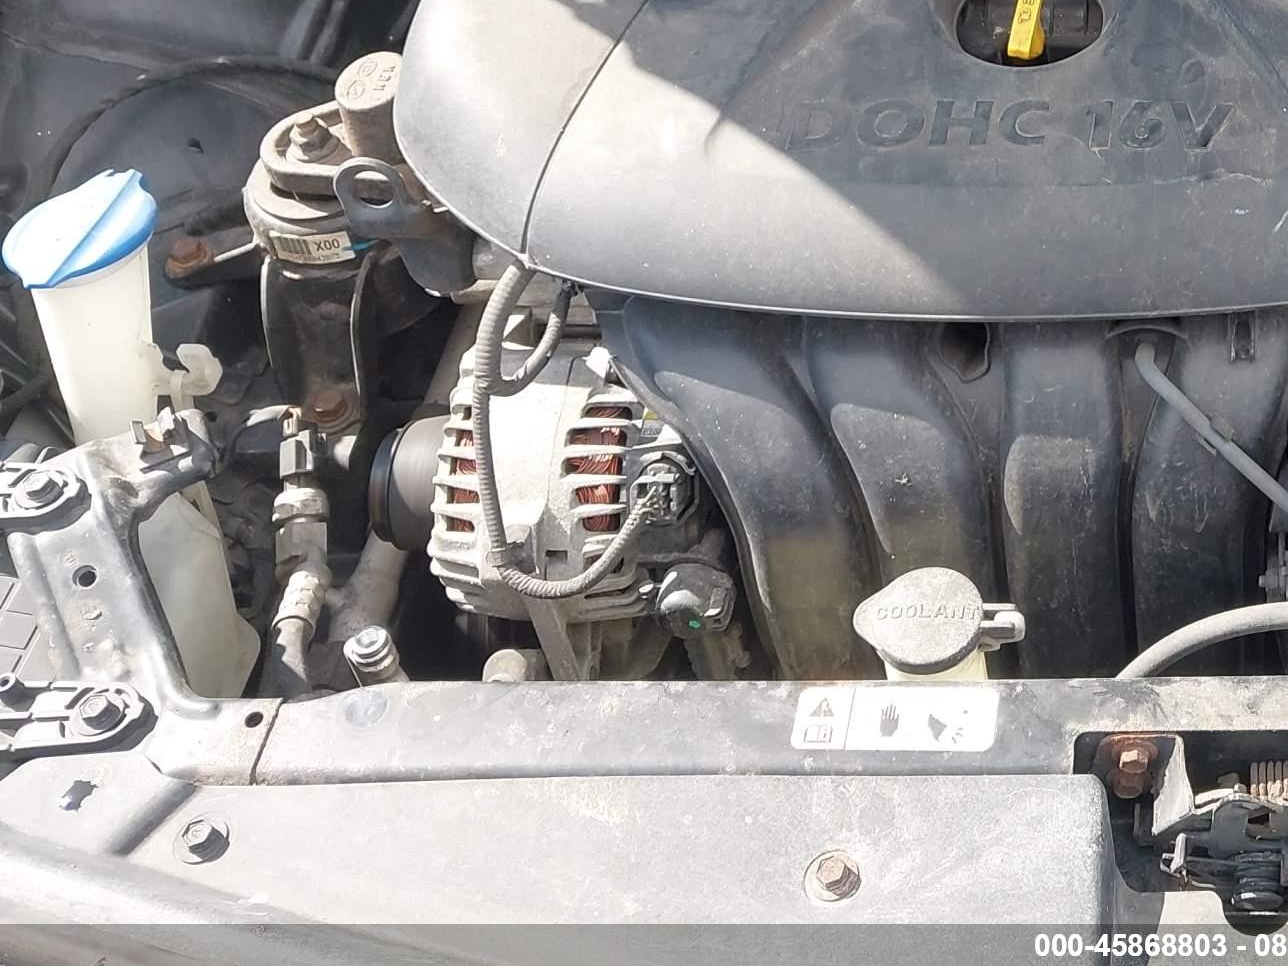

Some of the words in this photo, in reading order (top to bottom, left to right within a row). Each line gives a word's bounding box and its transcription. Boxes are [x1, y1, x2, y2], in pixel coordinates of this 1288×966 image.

[784, 99, 1050, 150] DOHC
[1085, 99, 1236, 150] 16V
[876, 603, 980, 620] COOLANT
